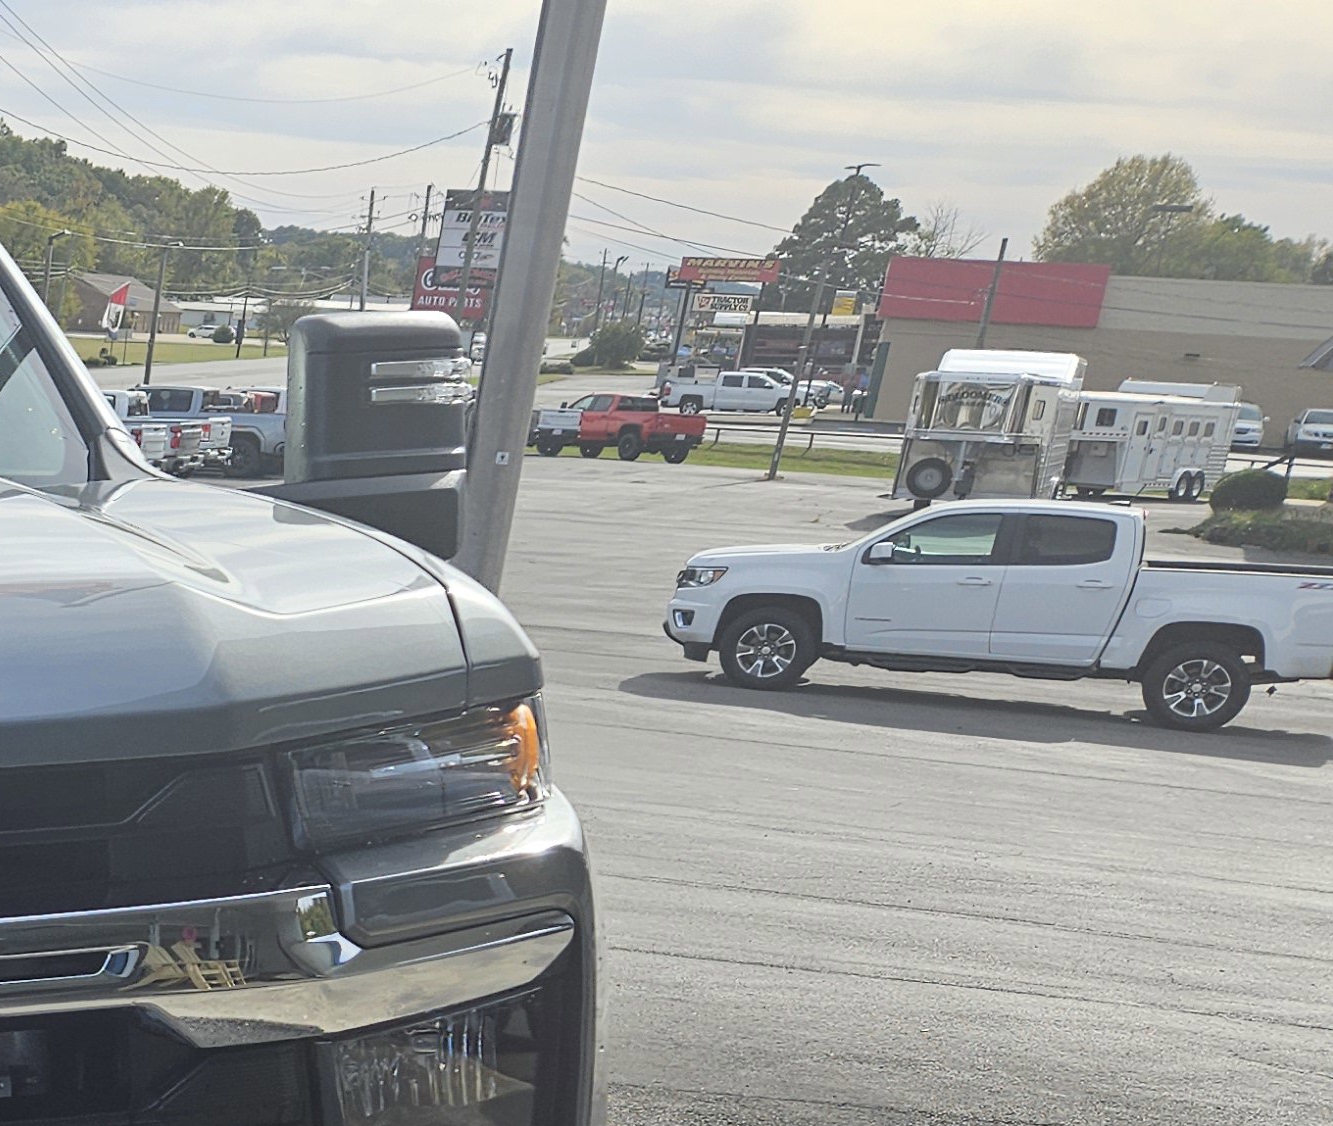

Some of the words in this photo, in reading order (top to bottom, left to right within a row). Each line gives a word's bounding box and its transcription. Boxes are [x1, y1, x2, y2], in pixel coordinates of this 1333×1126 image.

[686, 258, 775, 269] MARVIN'S
[417, 295, 446, 306] AUTO
[448, 296, 482, 308] PTS
[713, 296, 749, 304] TRACTOR
[710, 303, 739, 311] SUPPLY
